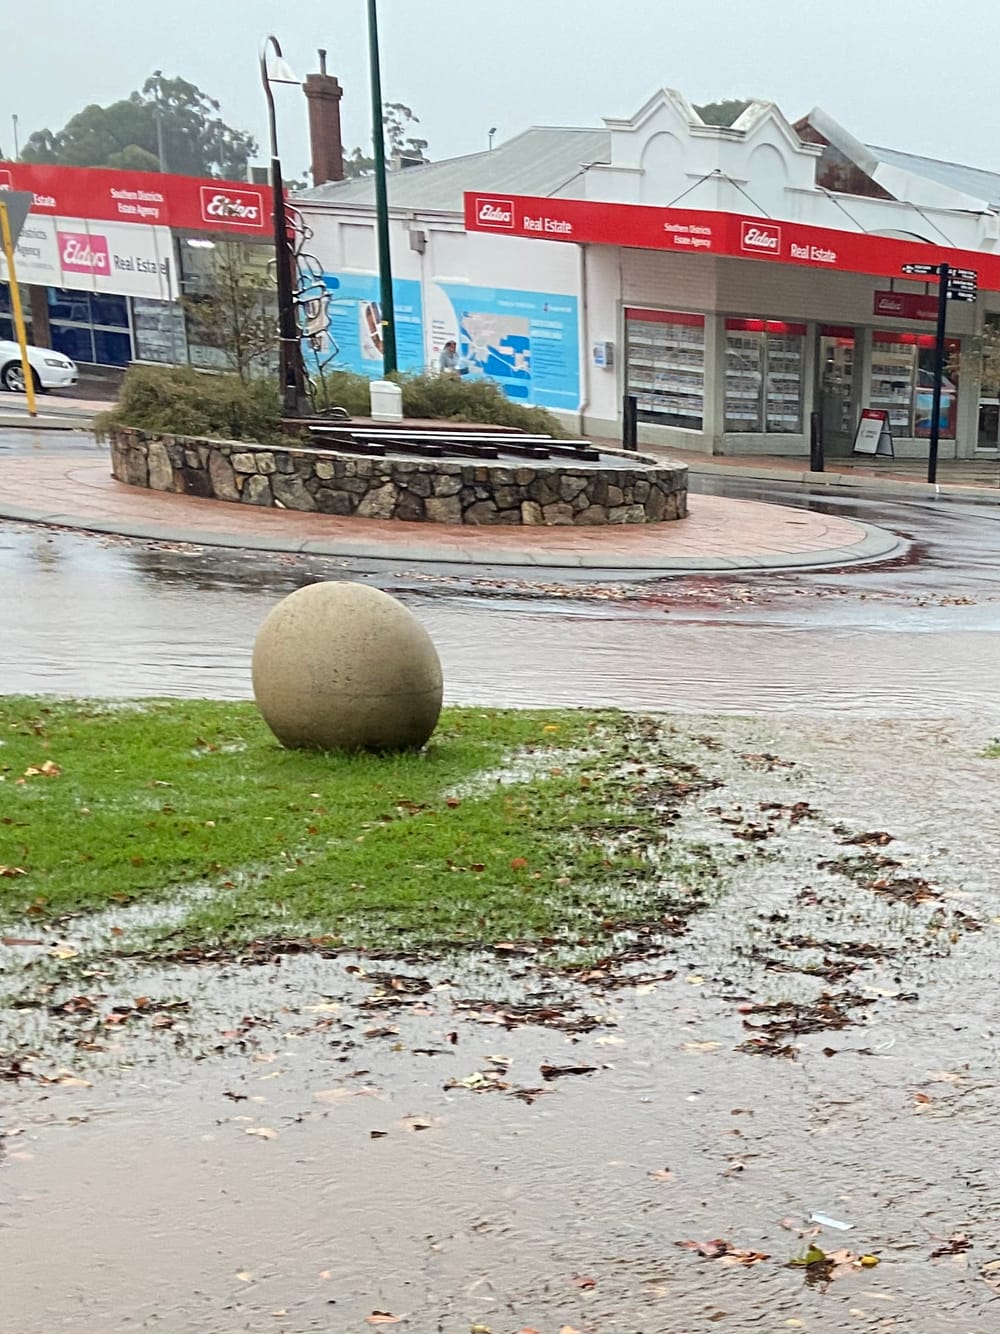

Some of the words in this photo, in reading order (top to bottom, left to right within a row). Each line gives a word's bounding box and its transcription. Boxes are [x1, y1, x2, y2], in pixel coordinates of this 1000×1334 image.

[207, 194, 259, 219] Elders
[479, 204, 512, 222] Elders
[523, 216, 543, 231] Real
[544, 217, 573, 233] Estate
[744, 228, 778, 248] Elders
[63, 240, 106, 268] Elders
[790, 243, 810, 260] Real
[810, 246, 838, 263] Estate
[113, 254, 135, 271] Real
[136, 257, 168, 275] Estae
